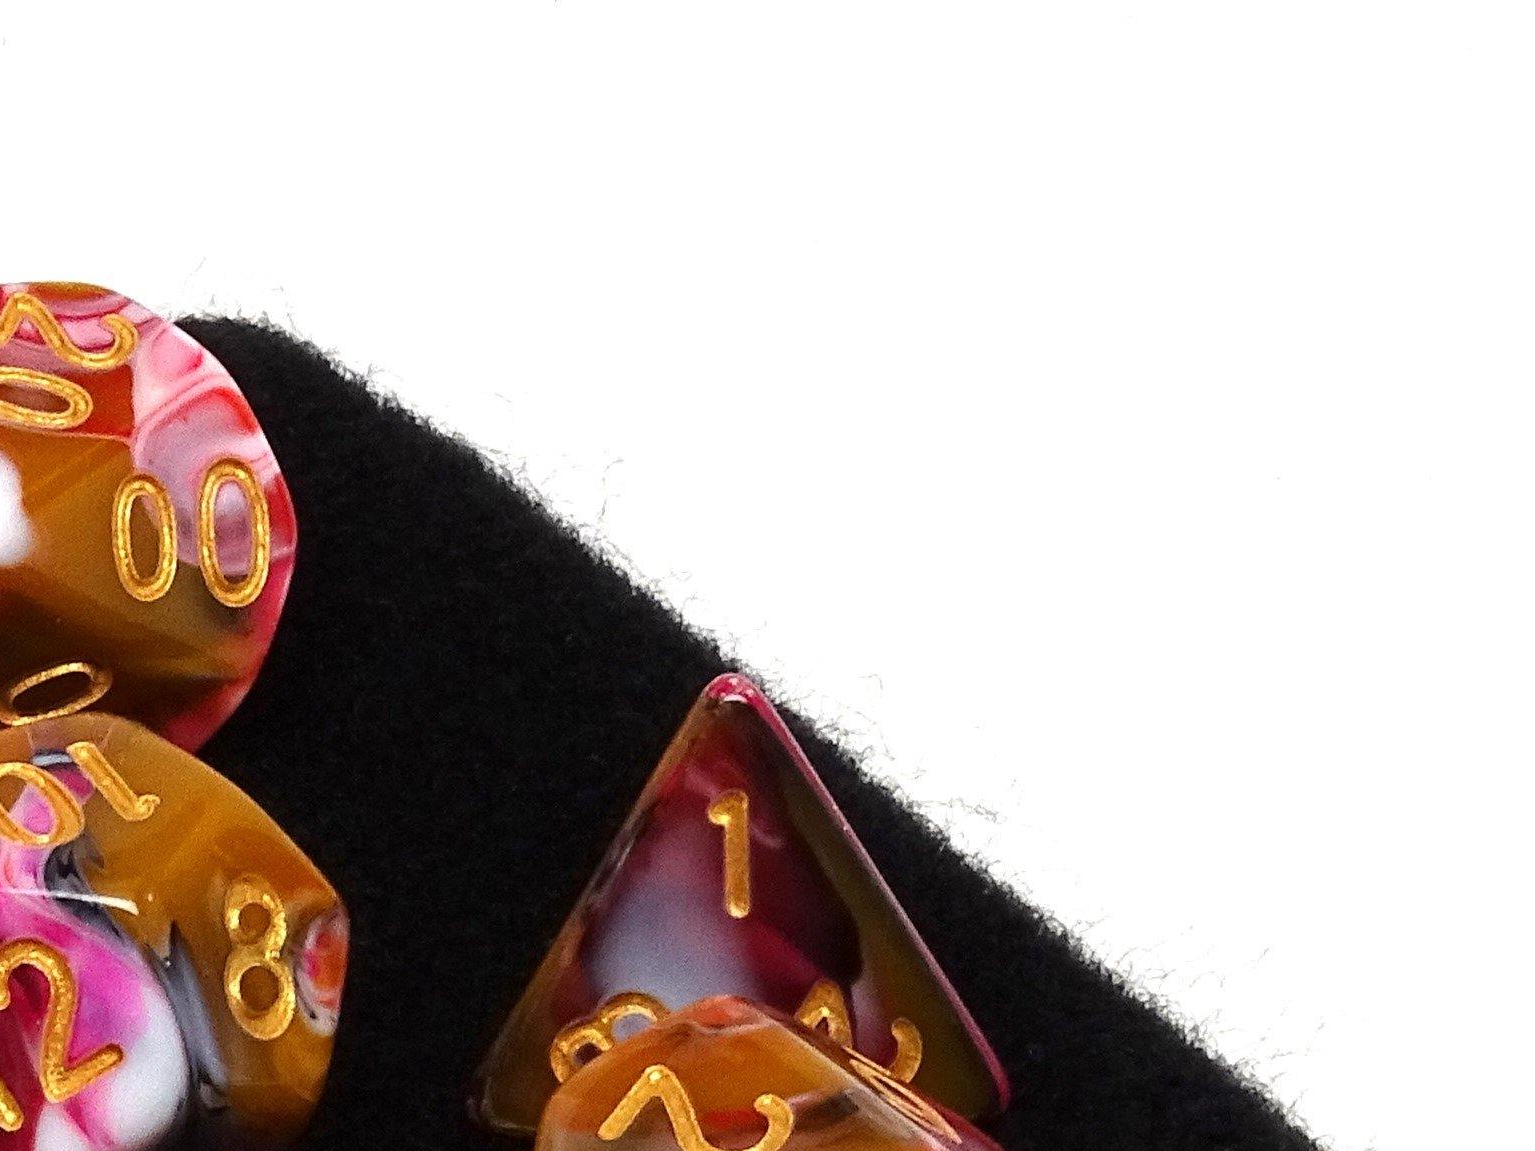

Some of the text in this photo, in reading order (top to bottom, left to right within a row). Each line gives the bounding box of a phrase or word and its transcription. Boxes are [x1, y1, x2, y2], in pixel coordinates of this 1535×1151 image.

[112, 459, 271, 608] 00
[707, 789, 752, 919] 1
[224, 873, 297, 1042] 8
